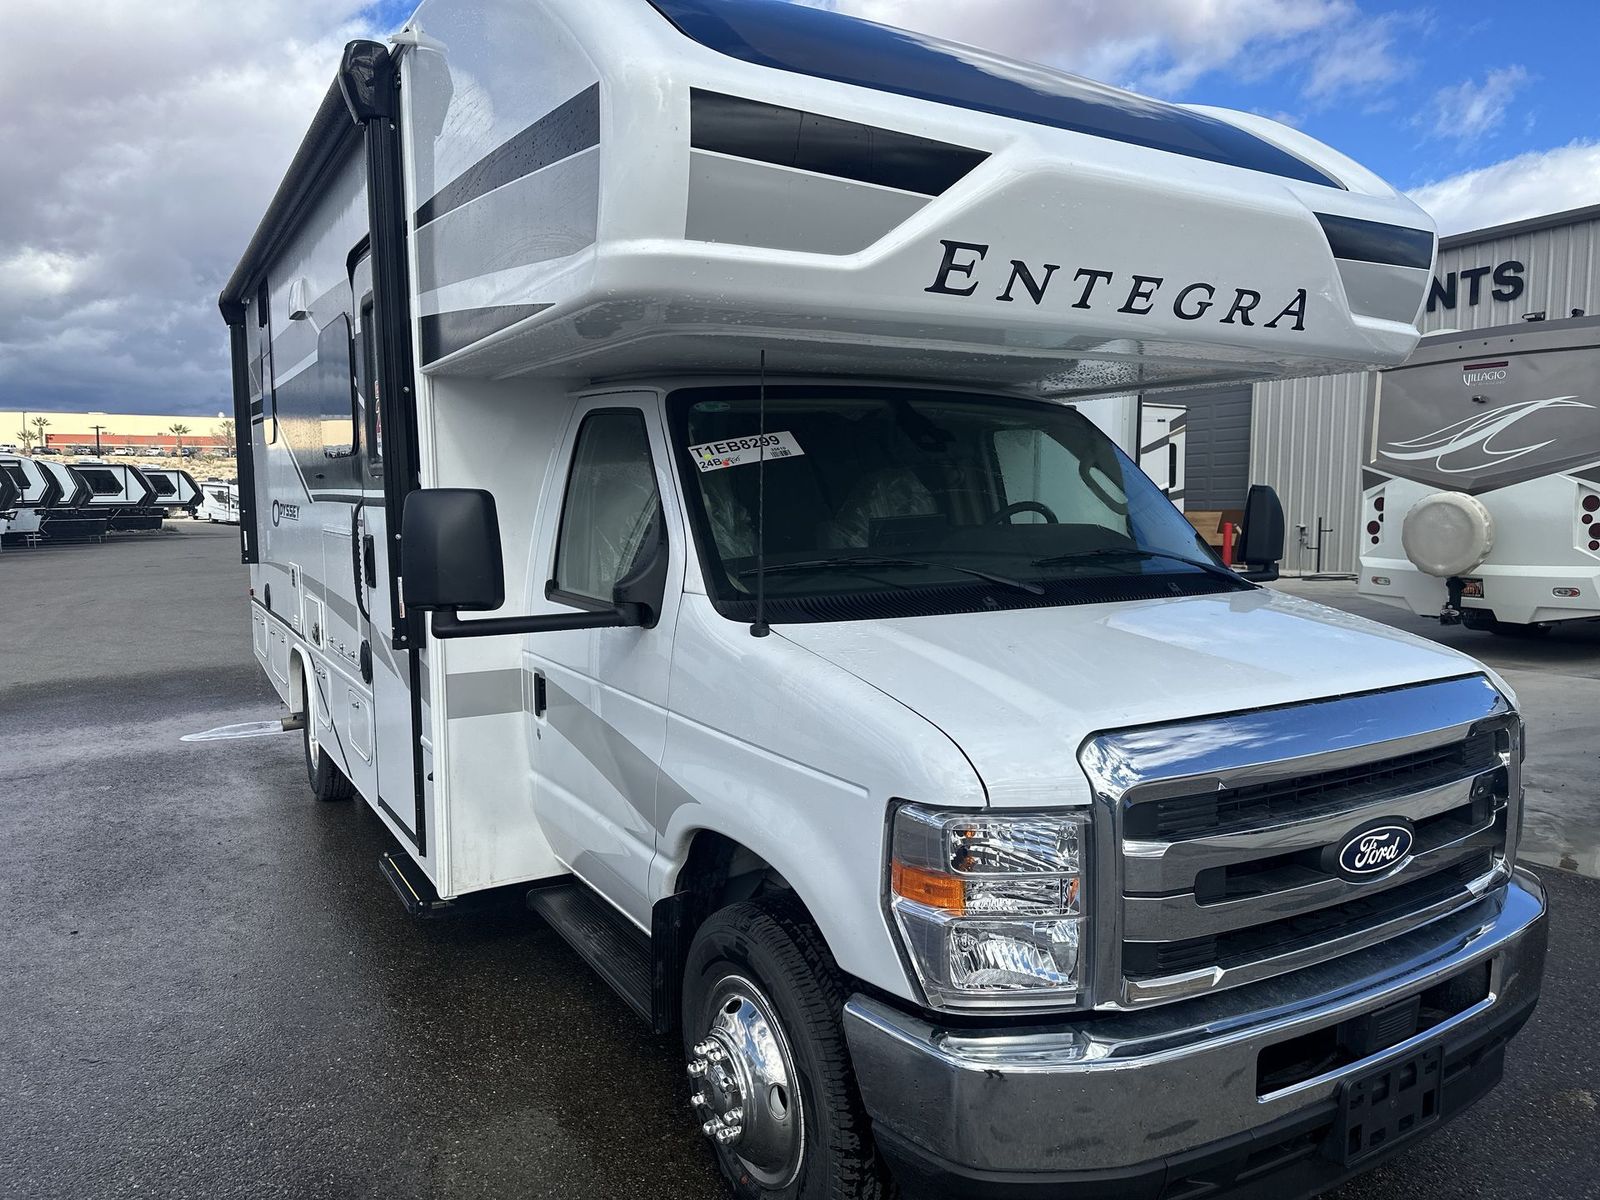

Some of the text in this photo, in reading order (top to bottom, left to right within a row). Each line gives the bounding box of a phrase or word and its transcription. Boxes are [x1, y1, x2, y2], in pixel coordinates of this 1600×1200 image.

[924, 239, 1308, 332] ENTEGRA
[1426, 260, 1525, 313] NTS
[1463, 370, 1507, 386] VILLAGIO
[691, 435, 780, 458] T1EB8299
[699, 458, 722, 469] 24B
[1354, 832, 1401, 868] Ford
